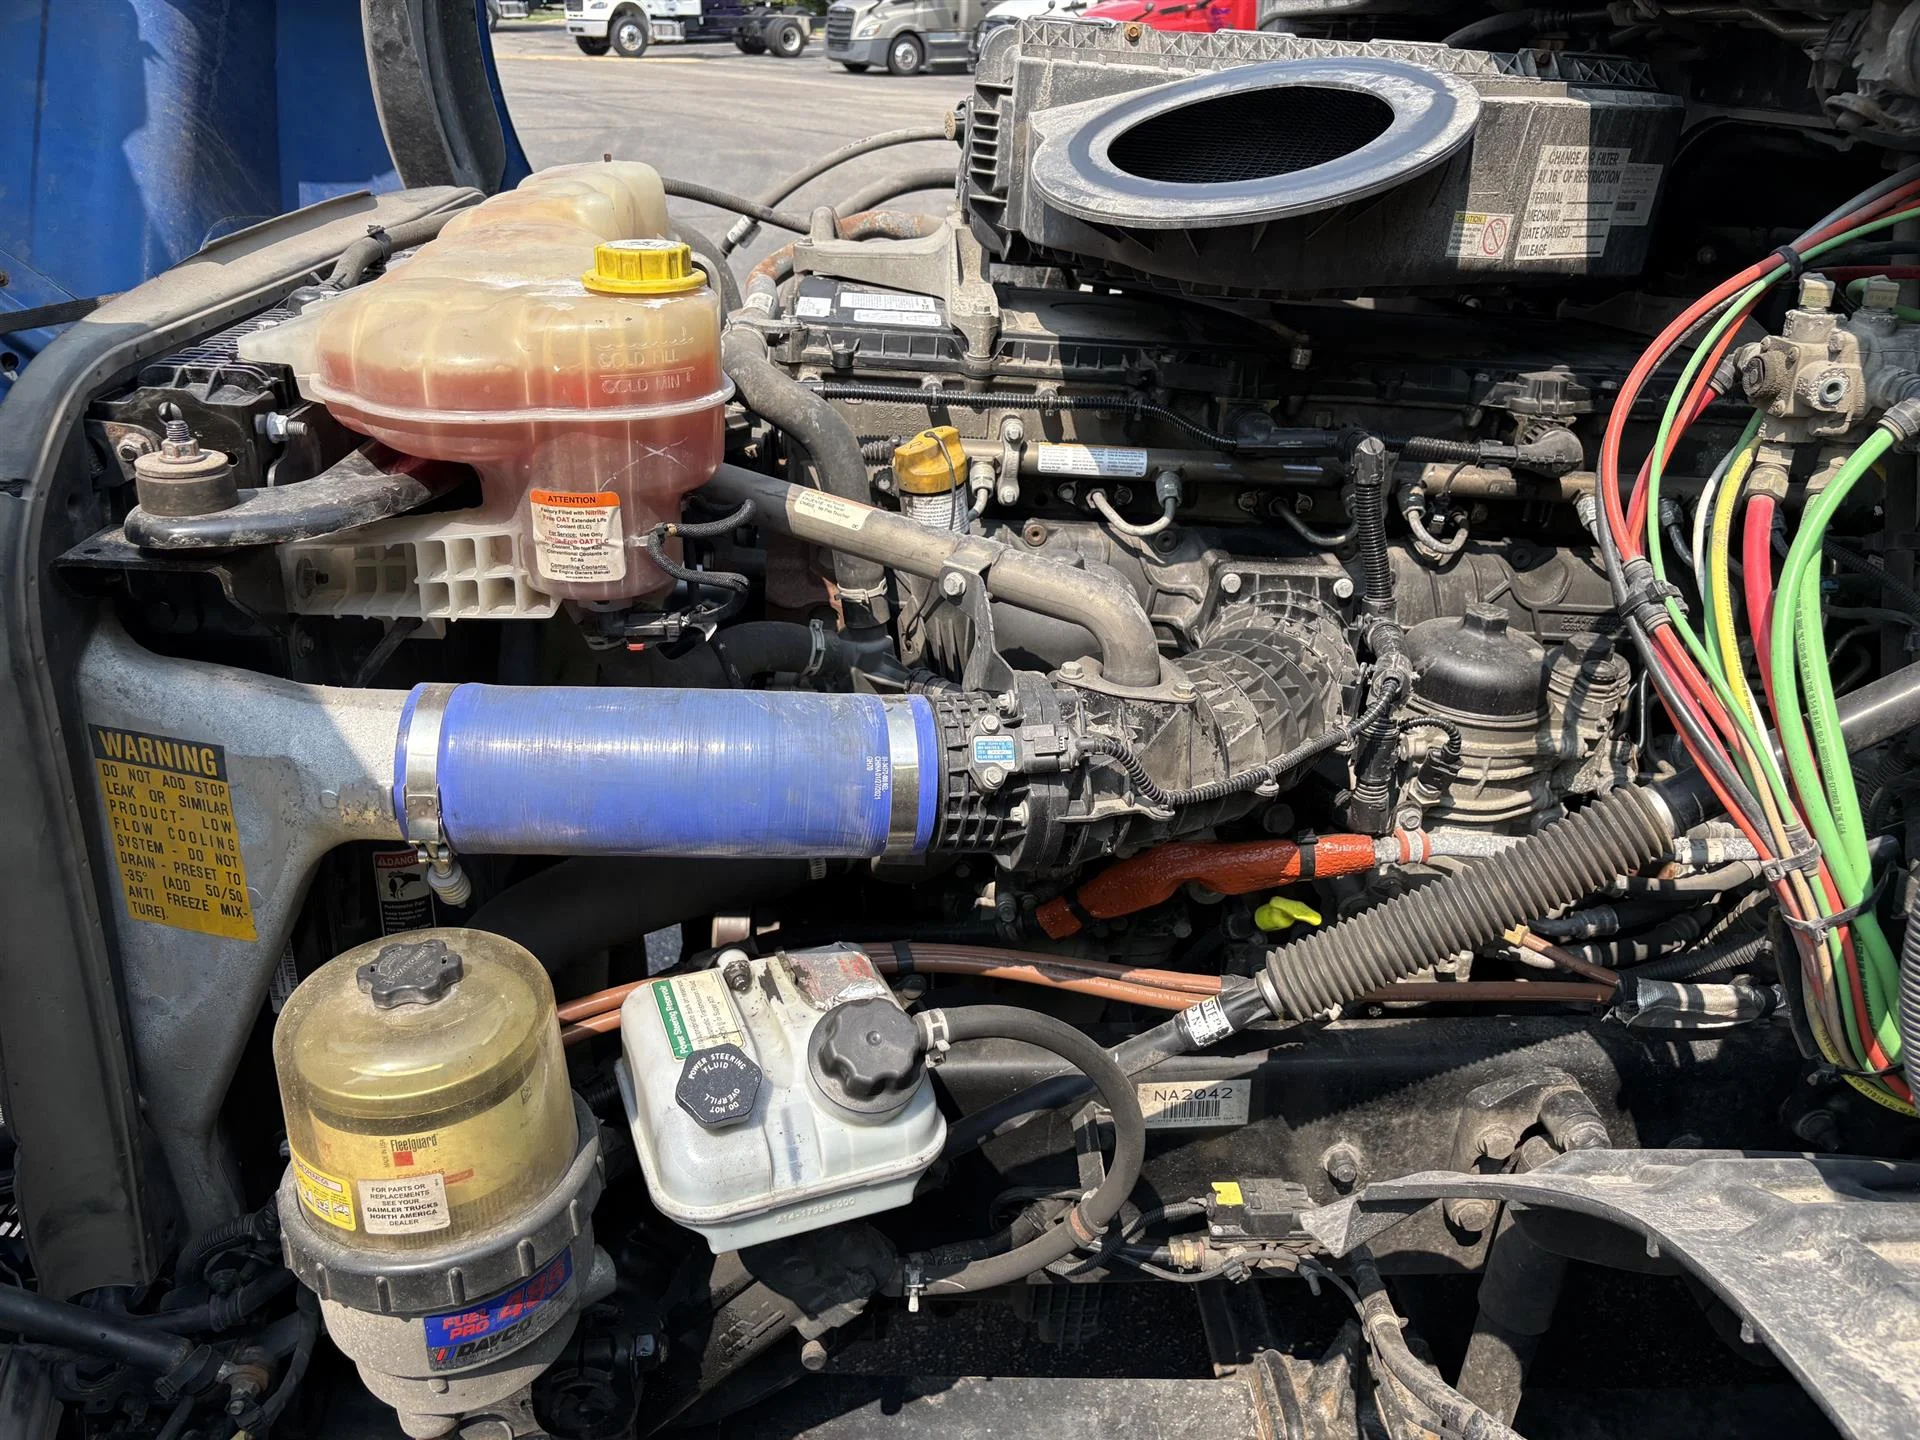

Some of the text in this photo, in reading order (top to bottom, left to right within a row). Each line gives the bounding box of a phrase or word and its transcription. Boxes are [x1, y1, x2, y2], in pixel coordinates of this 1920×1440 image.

[1549, 150, 1581, 164] CHANGE
[1596, 151, 1620, 165] FILTER
[1562, 169, 1573, 183] OF
[1573, 169, 1621, 184] RESTRICTION
[1521, 226, 1570, 239] DATE CHANGED
[1519, 244, 1547, 256] MILEAGE
[602, 379, 648, 393] COLD
[99, 730, 217, 777] WARNING
[102, 764, 225, 797] DO NOT ADD STOP
[106, 782, 229, 816] LEAK OR SIMILAR
[109, 800, 232, 834] PRODUCT- LOW
[113, 817, 235, 851] FLOW COOLING
[117, 835, 164, 855] SYSTEM
[189, 848, 204, 862] DO
[216, 852, 237, 869] NOT
[120, 852, 156, 869] DRAIN
[174, 862, 217, 881] PRESET
[226, 872, 241, 886] TO
[163, 876, 191, 892] (ADD
[205, 884, 242, 902] 50/50
[129, 886, 247, 918] ANTI FREEZE MIX-
[658, 983, 688, 1054] Power Steering Reservoir
[688, 1053, 746, 1080] POWER STEERING
[702, 1062, 729, 1074] FLUID
[705, 1088, 740, 1105] OVERFILL
[1154, 1087, 1233, 1101] NA2042
[729, 1102, 740, 1111] DO
[391, 1135, 437, 1152] Fleetguard
[370, 1190, 430, 1199] REPLACEMENTS
[400, 1209, 437, 1219] AMERICA
[405, 1202, 438, 1211] TRUCKS
[442, 1309, 490, 1330] FUEL
[450, 1320, 490, 1339] PRO
